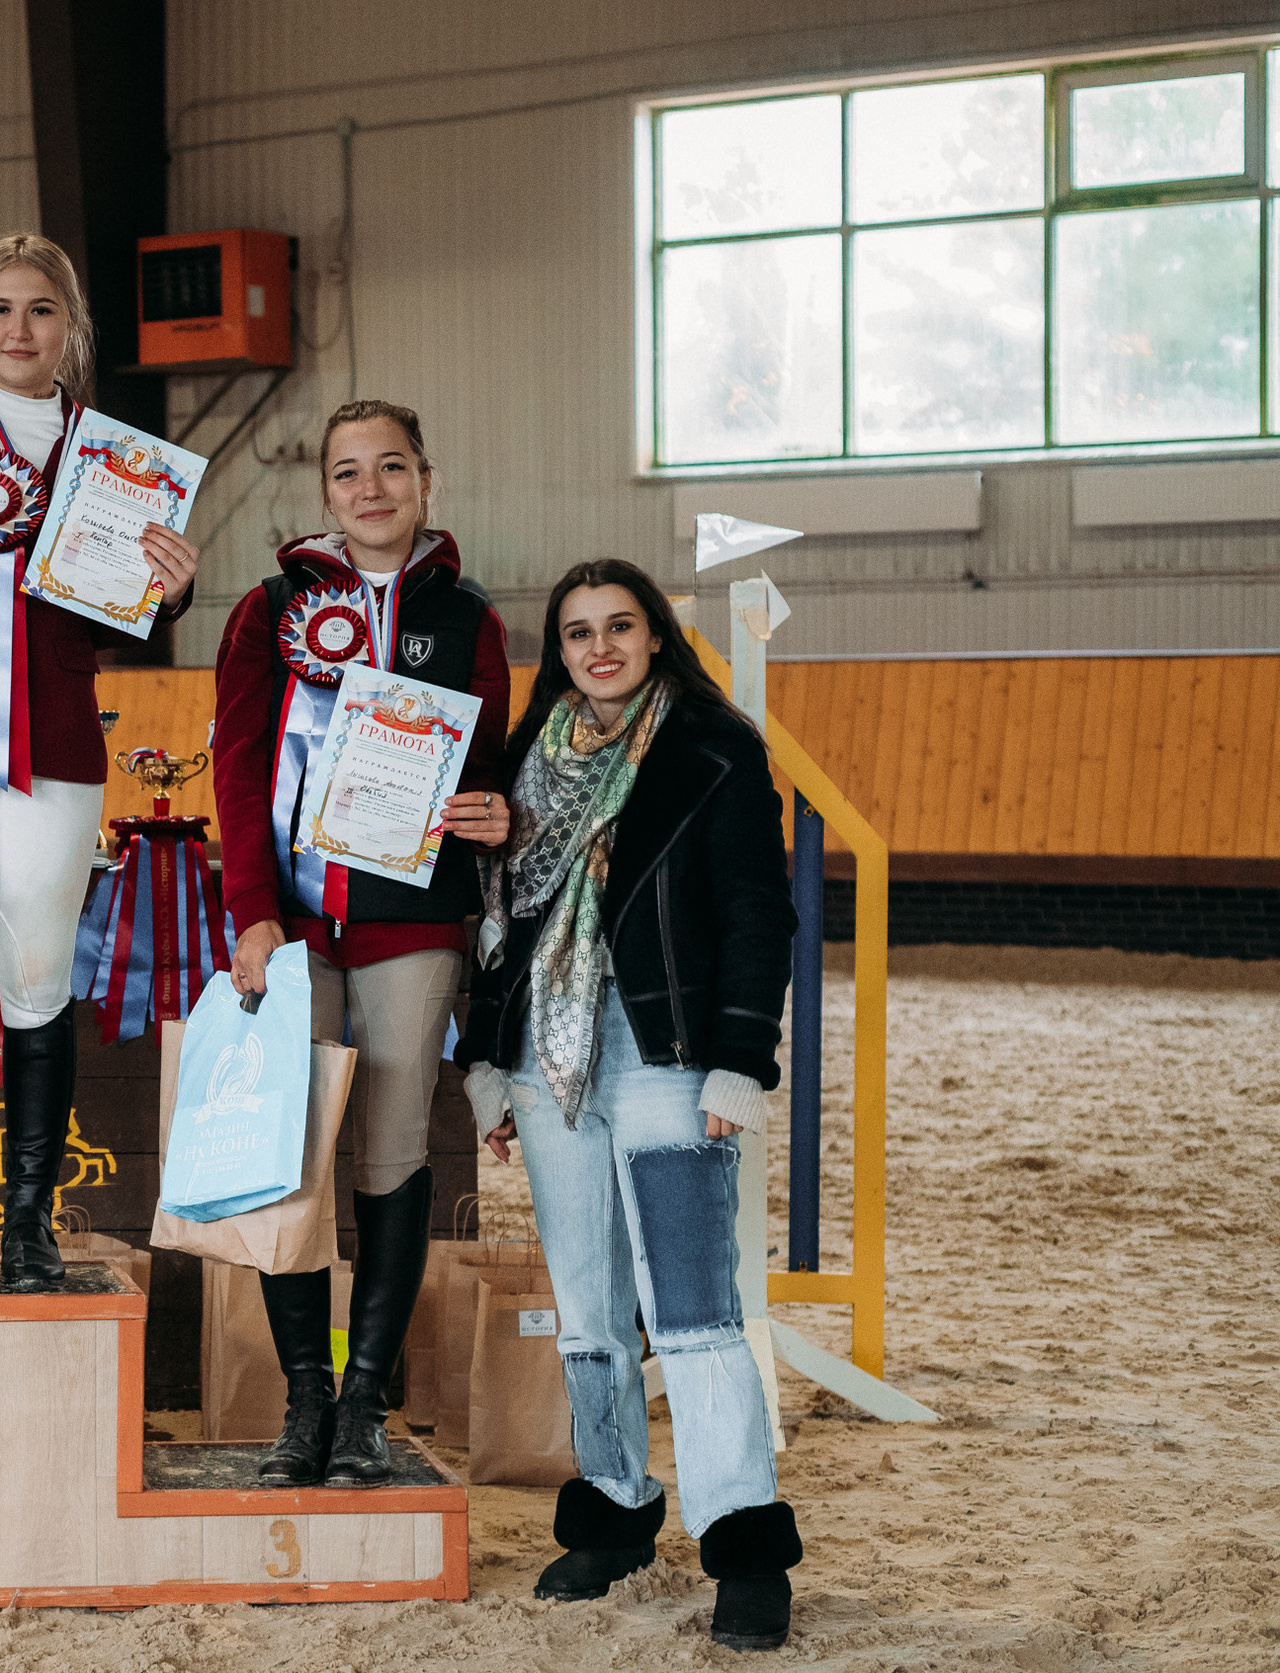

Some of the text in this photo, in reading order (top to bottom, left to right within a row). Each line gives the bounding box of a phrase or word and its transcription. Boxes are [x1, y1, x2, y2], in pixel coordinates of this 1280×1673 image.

[91, 470, 162, 510] ГРАМОТА
[84, 502, 147, 530] НАГРАЖДАЕТ
[319, 633, 350, 641] ИСТОРИЯ
[358, 723, 436, 756] ГРАМОТА
[352, 756, 428, 782] НАГРАЖДАЕТСЯ
[208, 1132, 269, 1160] КОНЕ»
[266, 1519, 302, 1578] 3
